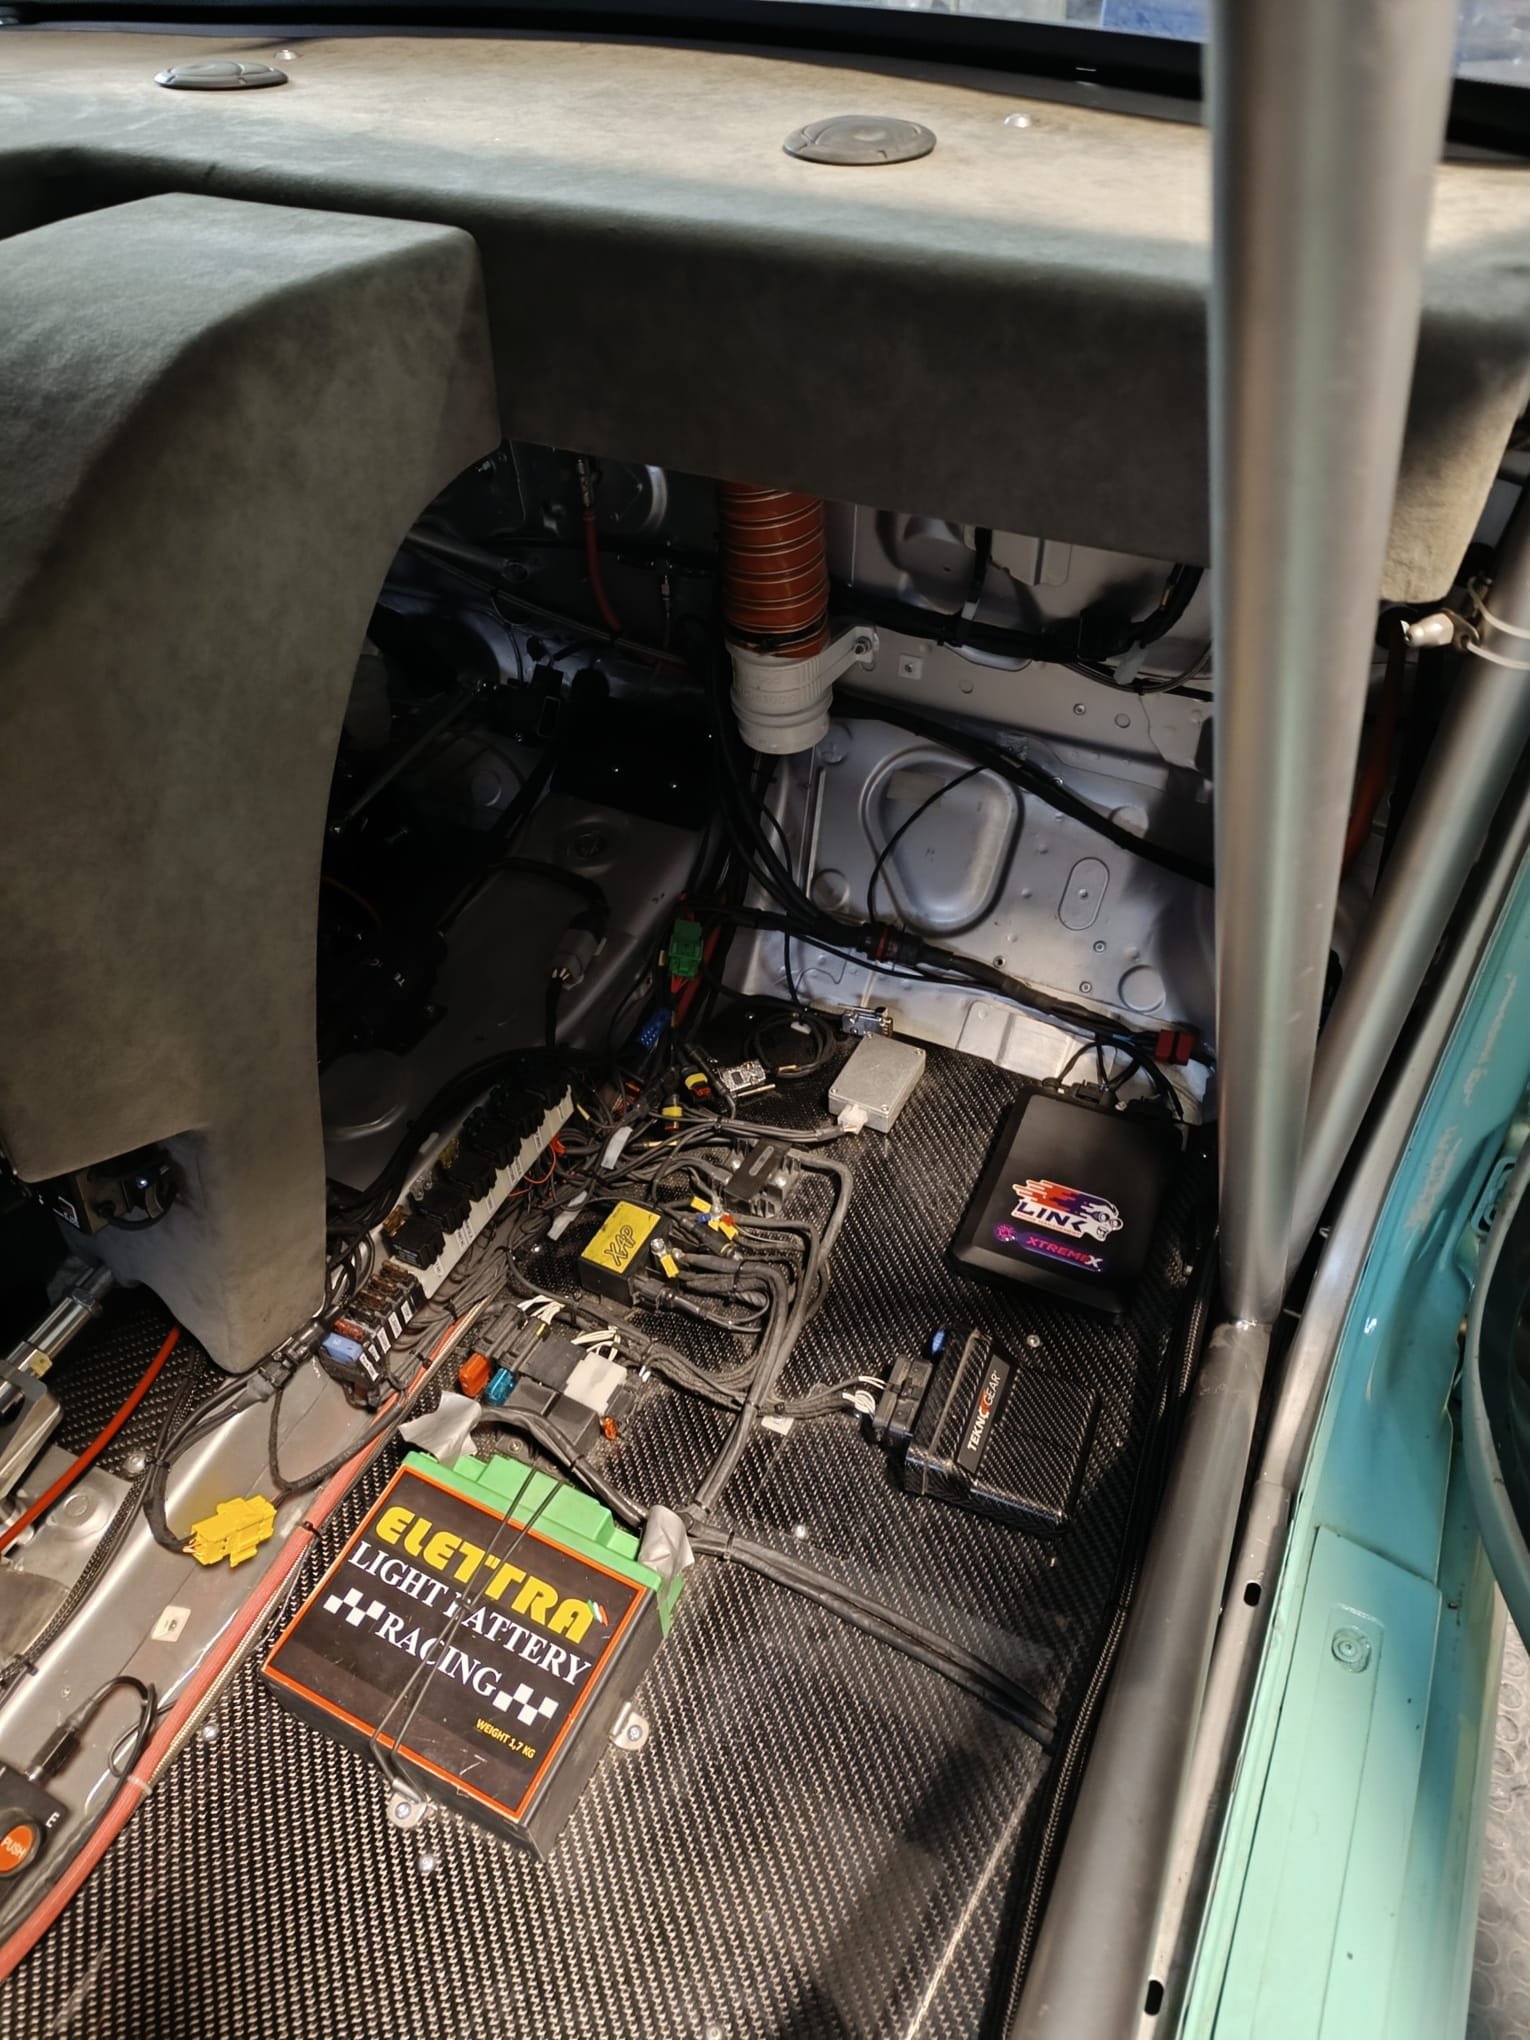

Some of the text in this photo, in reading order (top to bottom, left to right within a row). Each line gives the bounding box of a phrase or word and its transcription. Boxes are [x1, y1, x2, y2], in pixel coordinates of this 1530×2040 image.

[1017, 1201, 1087, 1232] LINK
[604, 1225, 636, 1266] XAP
[348, 1541, 449, 1608] LIGHT
[376, 1507, 593, 1643] ELETTRA
[375, 1612, 502, 1697] RACING
[475, 1718, 536, 1759] WEIGHT 1,7 KG
[0, 1836, 27, 1858] PUSH
